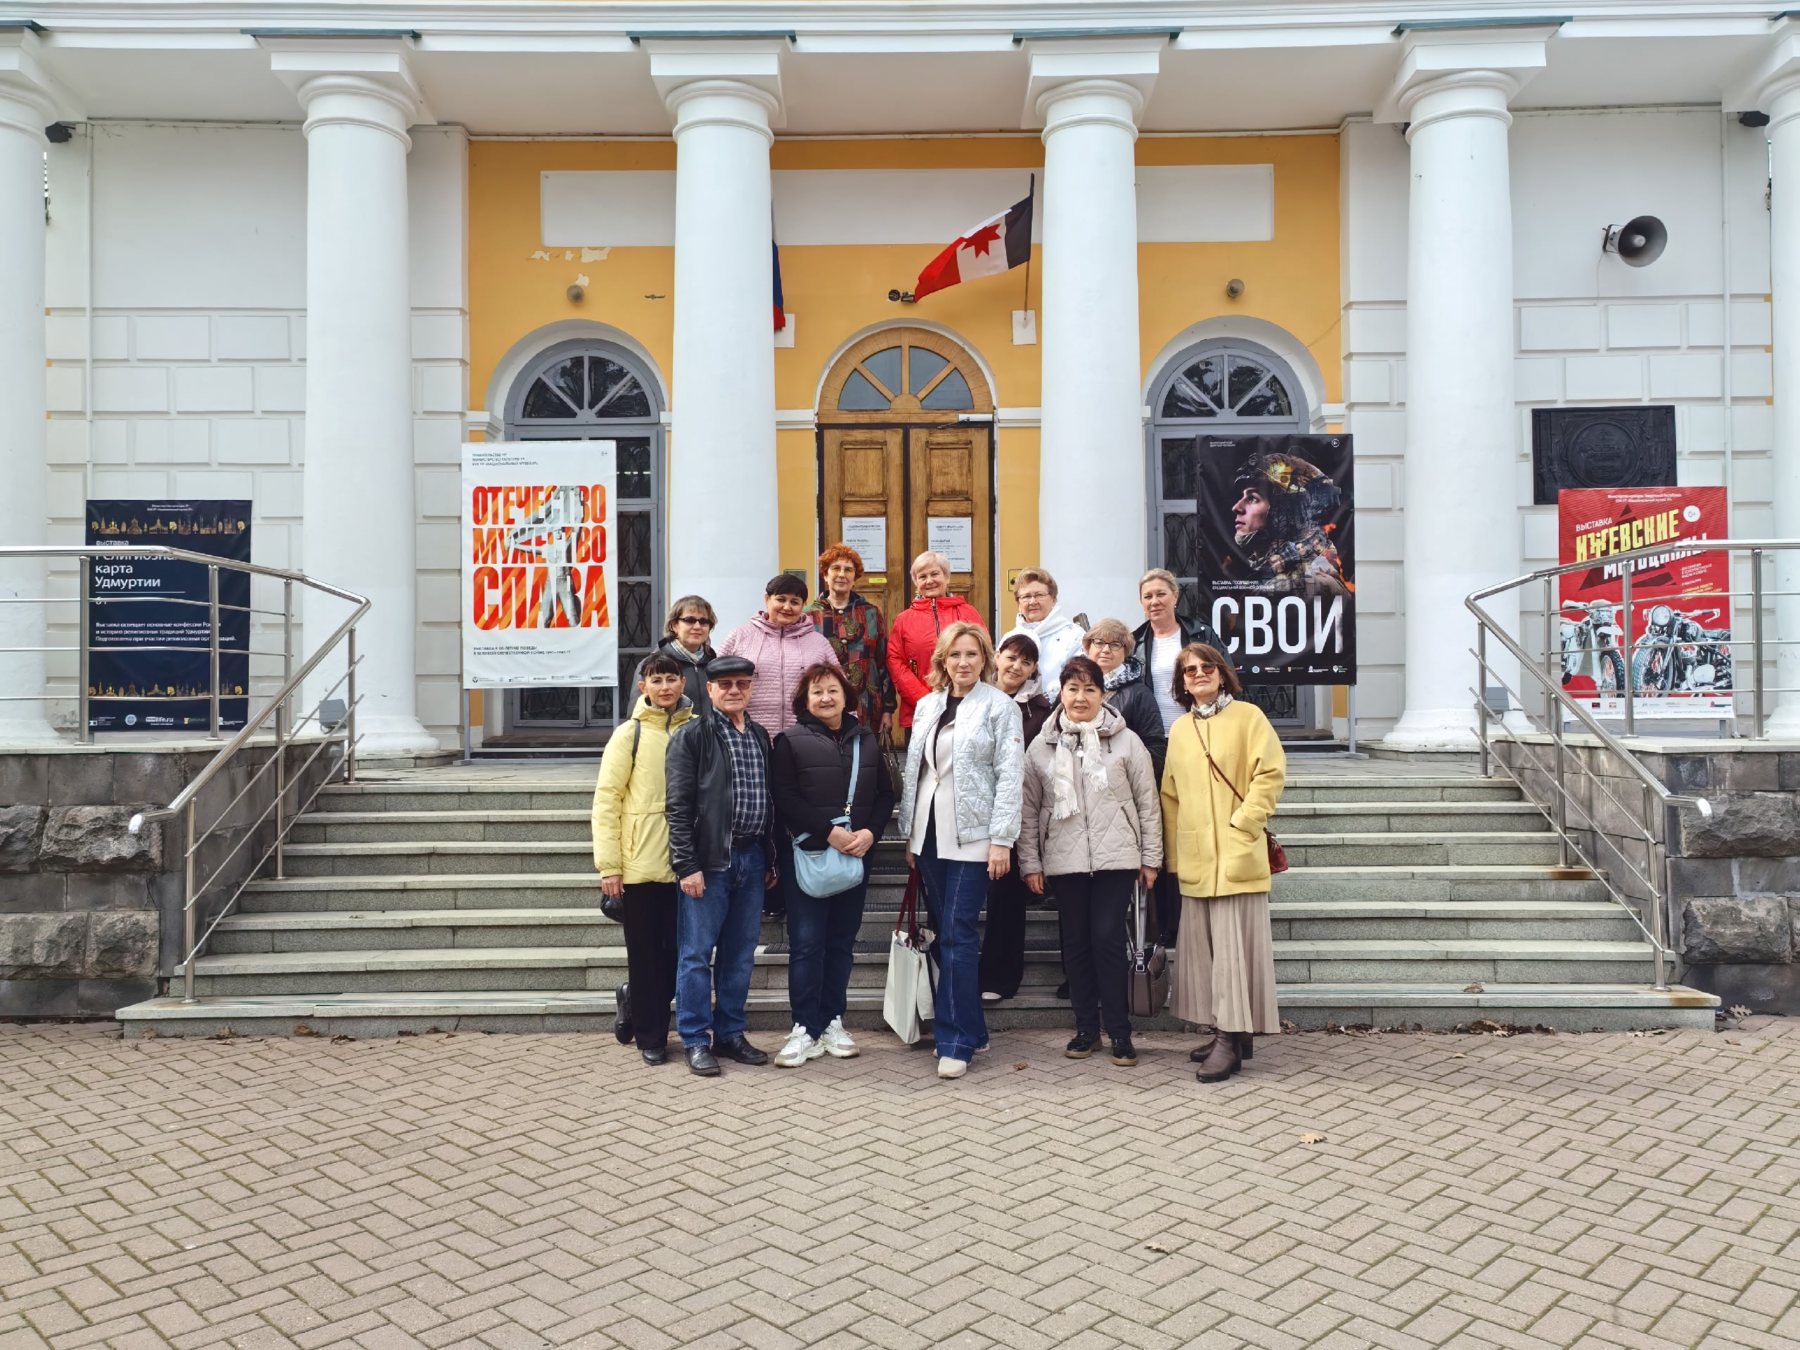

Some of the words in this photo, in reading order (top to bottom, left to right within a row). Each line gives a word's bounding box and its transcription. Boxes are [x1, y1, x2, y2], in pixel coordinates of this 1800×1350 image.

[472, 484, 606, 526] ОТЕЧЕСТВО
[1576, 517, 1612, 532] ВЫСТАВКА
[472, 525, 606, 565] МУЖЕСТВО
[1576, 509, 1680, 562] ИЖЕВСКИЕ
[95, 565, 133, 576] карта
[95, 576, 161, 590] Удмуртии
[473, 565, 610, 630] СЛАВА
[1211, 596, 1343, 655] СВОИ
